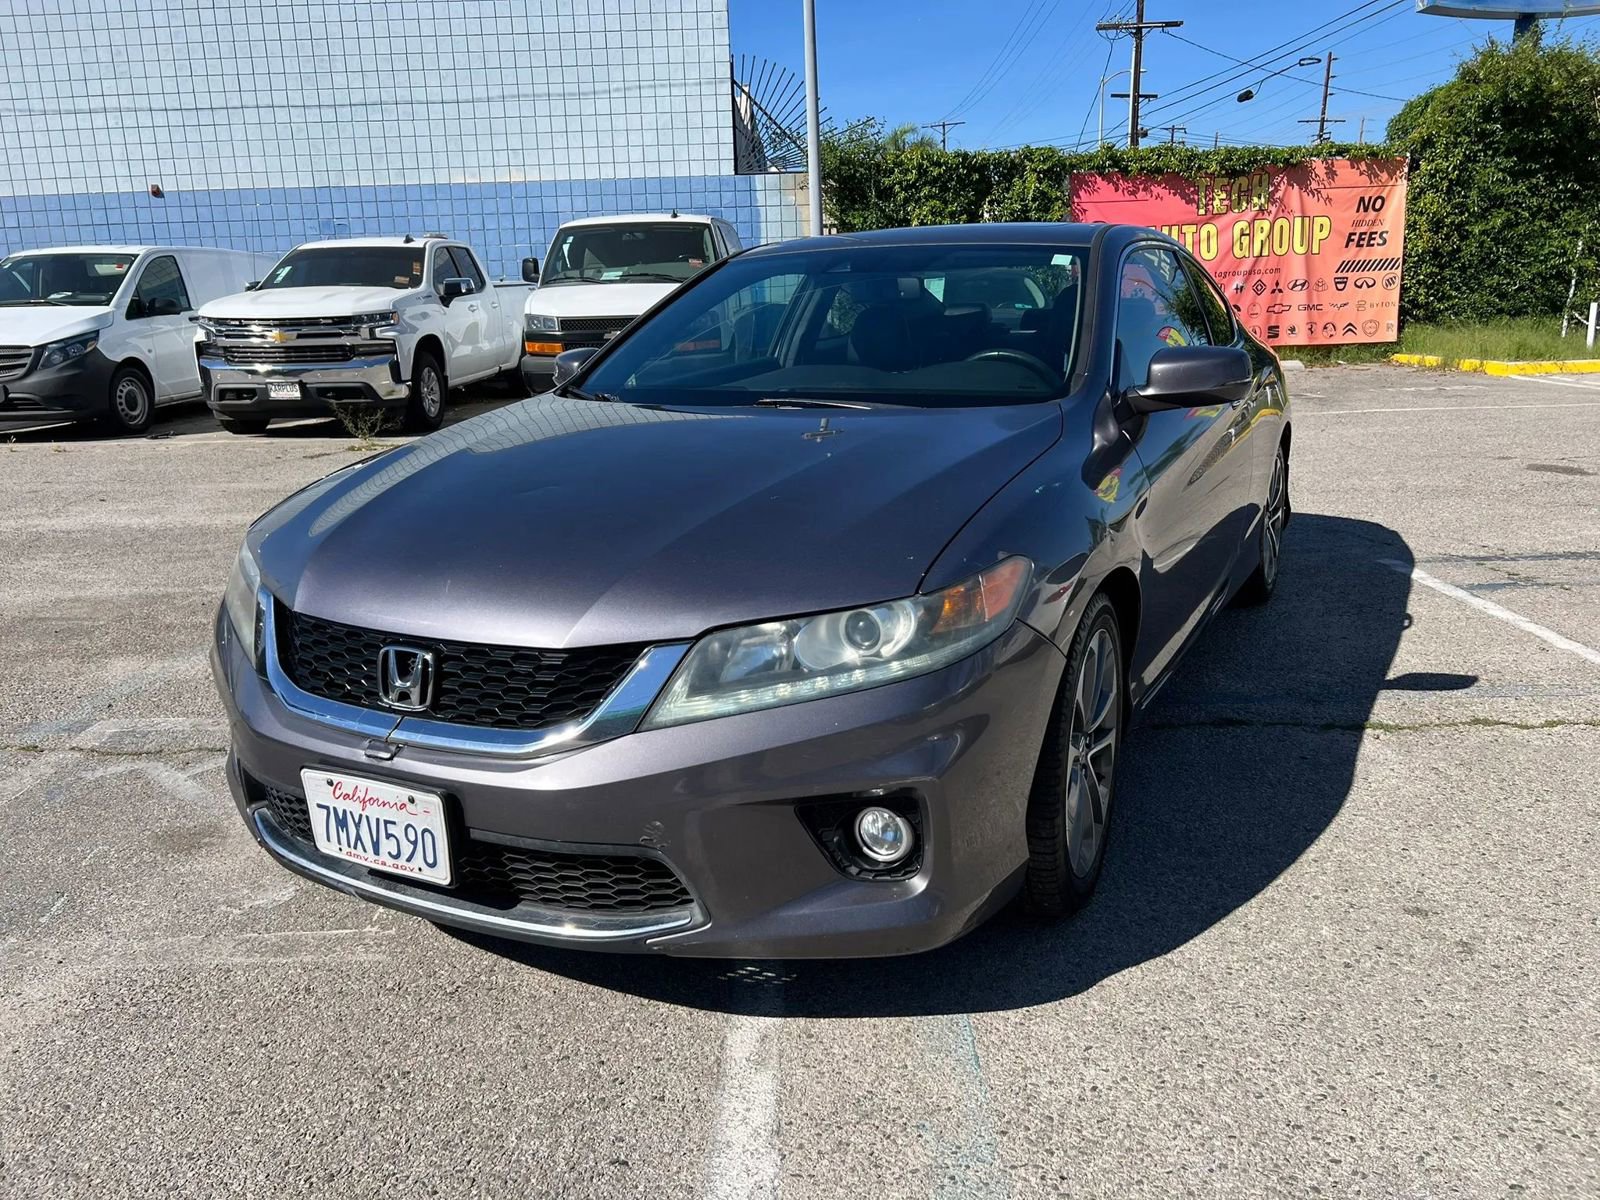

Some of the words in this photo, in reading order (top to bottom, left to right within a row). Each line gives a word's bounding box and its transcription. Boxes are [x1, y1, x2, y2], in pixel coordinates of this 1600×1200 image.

[1195, 173, 1271, 216] TECH
[1355, 195, 1386, 213] NO
[1351, 219, 1385, 228] HIDDEN
[1147, 223, 1219, 262] TO
[1232, 215, 1332, 260] GROUP
[1344, 230, 1389, 249] FEES
[1297, 303, 1324, 311] GMC
[332, 781, 418, 816] California
[316, 803, 438, 869] 7MXV590
[345, 850, 416, 872] dmv.ca.gov
